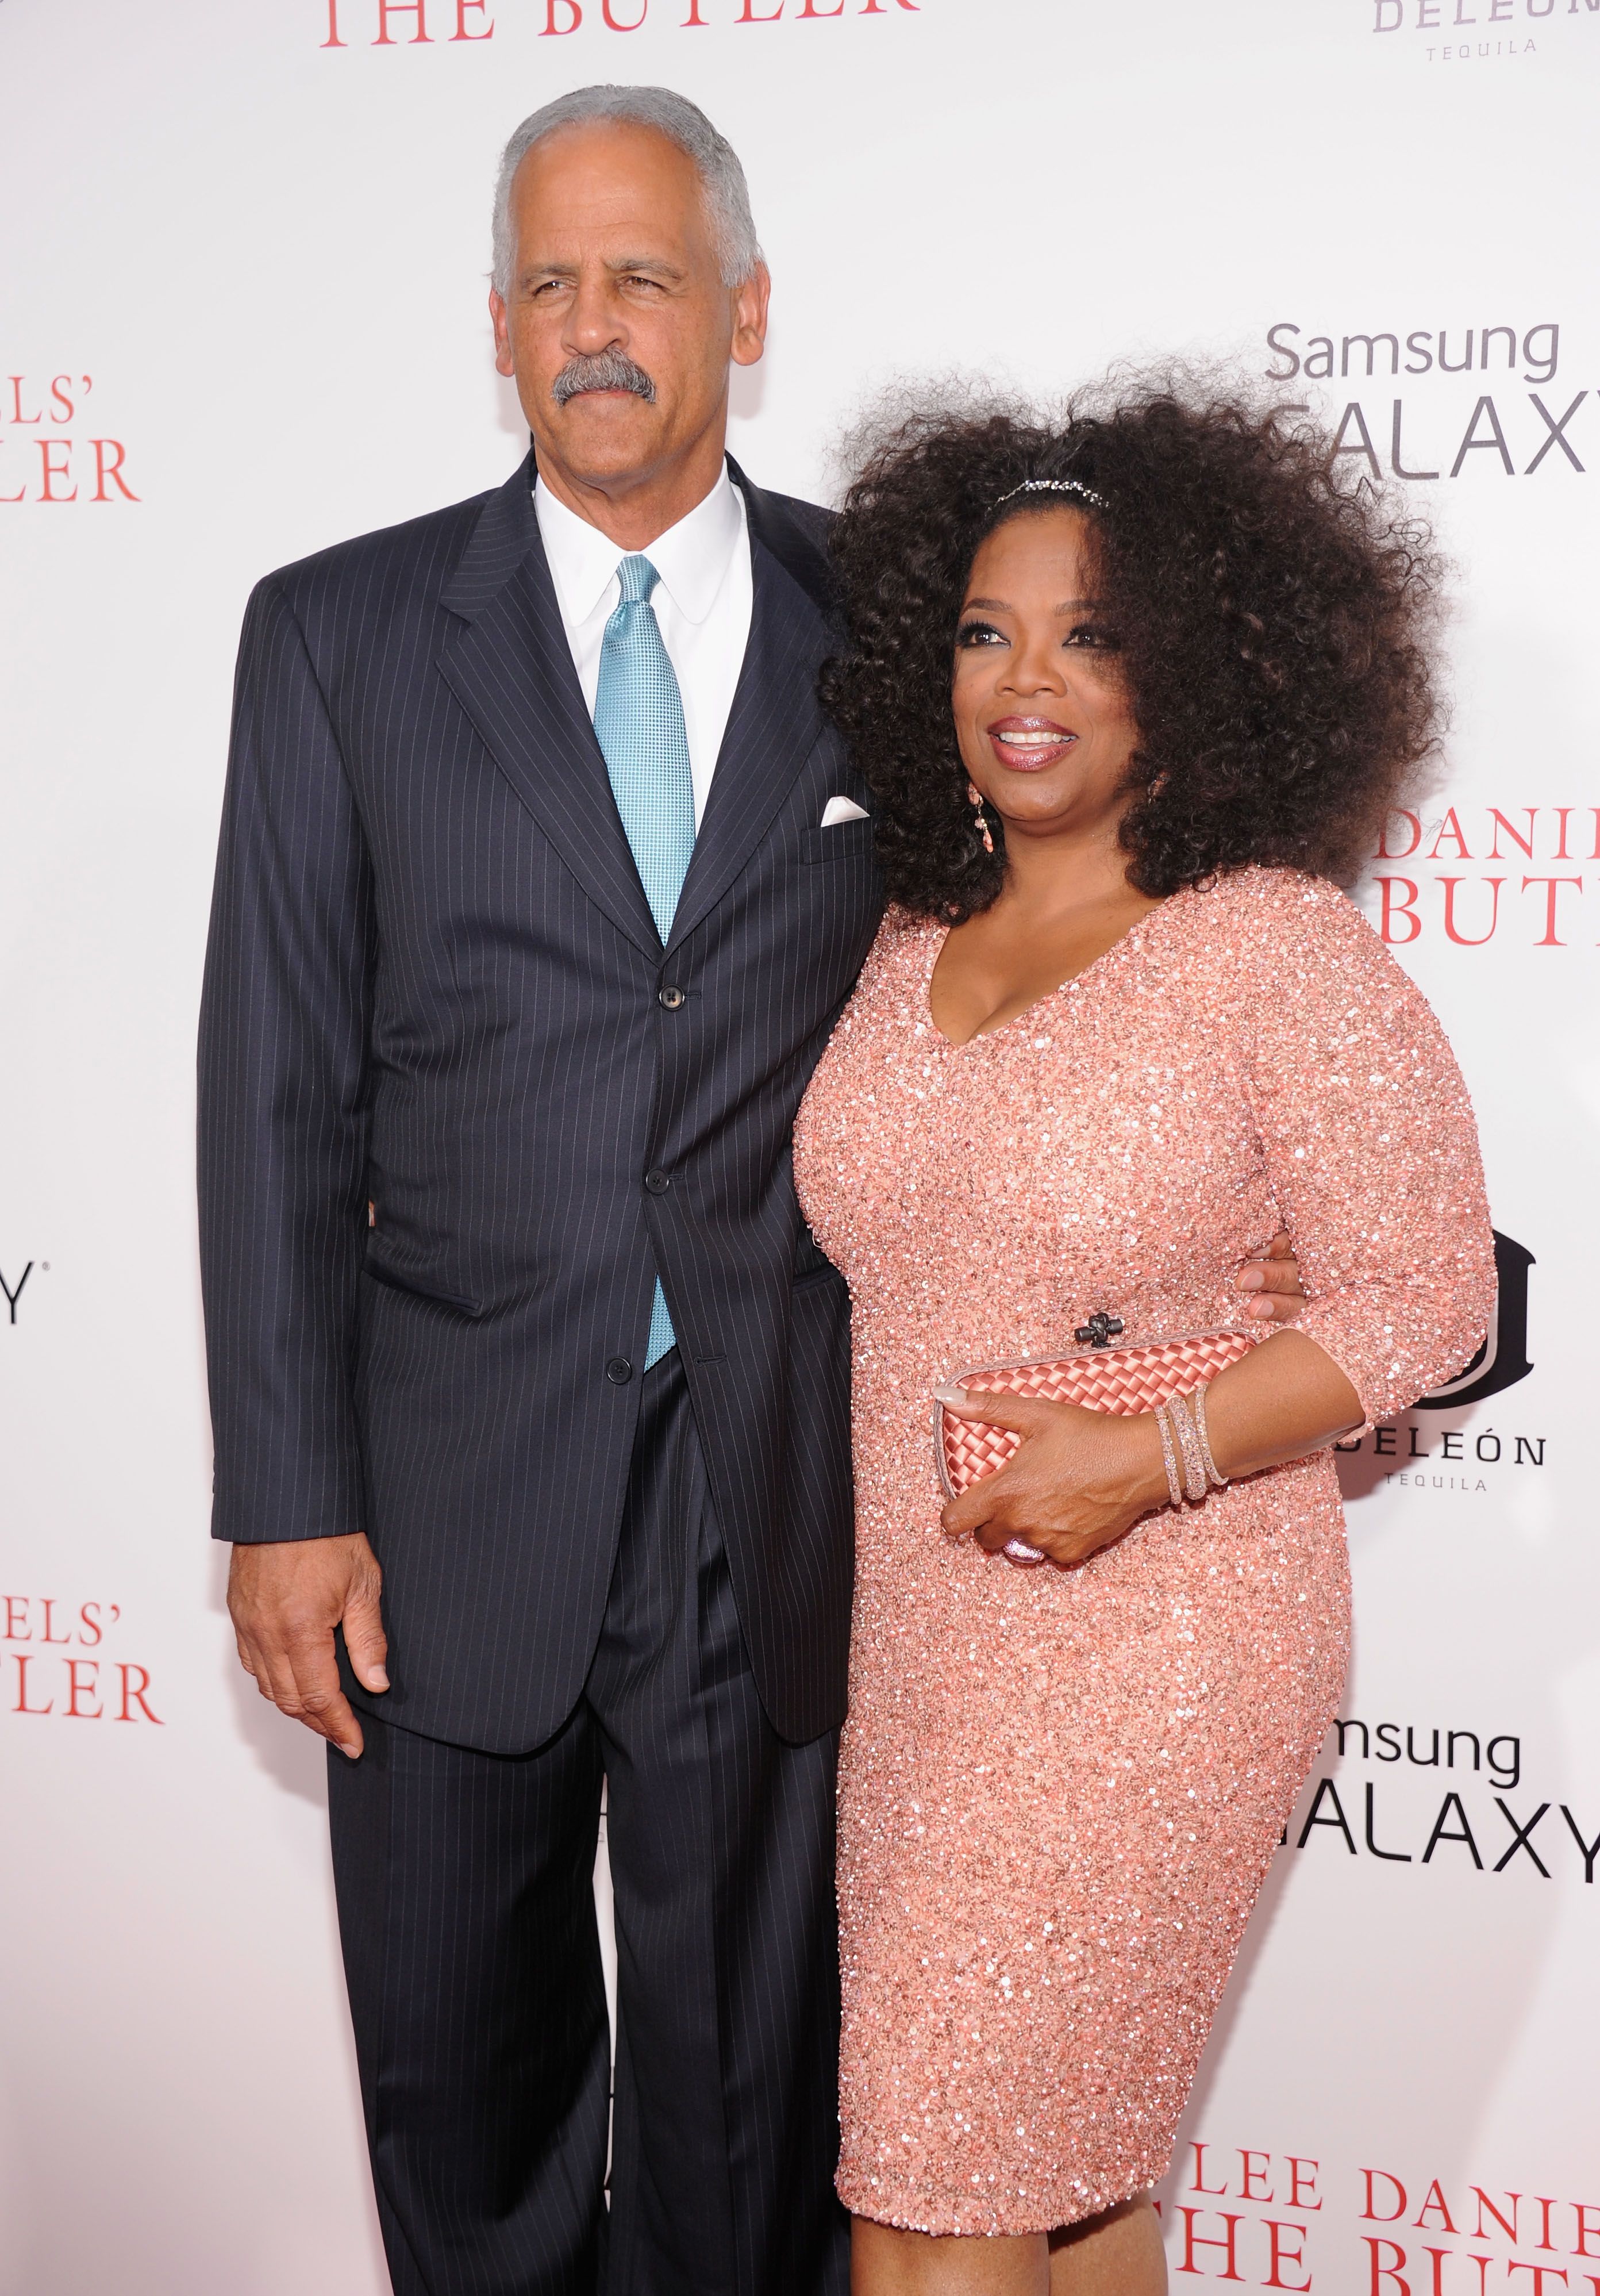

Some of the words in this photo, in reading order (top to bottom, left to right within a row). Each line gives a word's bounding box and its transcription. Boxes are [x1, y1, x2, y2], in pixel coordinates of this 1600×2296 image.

[1426, 39, 1536, 62] TEQUILA
[1264, 323, 1559, 383] Samsung
[0, 374, 93, 424] LS’
[1263, 390, 1600, 481] ALAX
[1372, 875, 1600, 947] BUT
[1384, 1473, 1487, 1491] TEQUILA
[0, 1653, 166, 1725] LER
[1318, 1718, 1520, 1790] msung
[1277, 1778, 1600, 1884] ALAXY
[1187, 2141, 1324, 2210] LEE
[1152, 2200, 1312, 2293] HE
[1360, 2236, 1600, 2296] BUT
